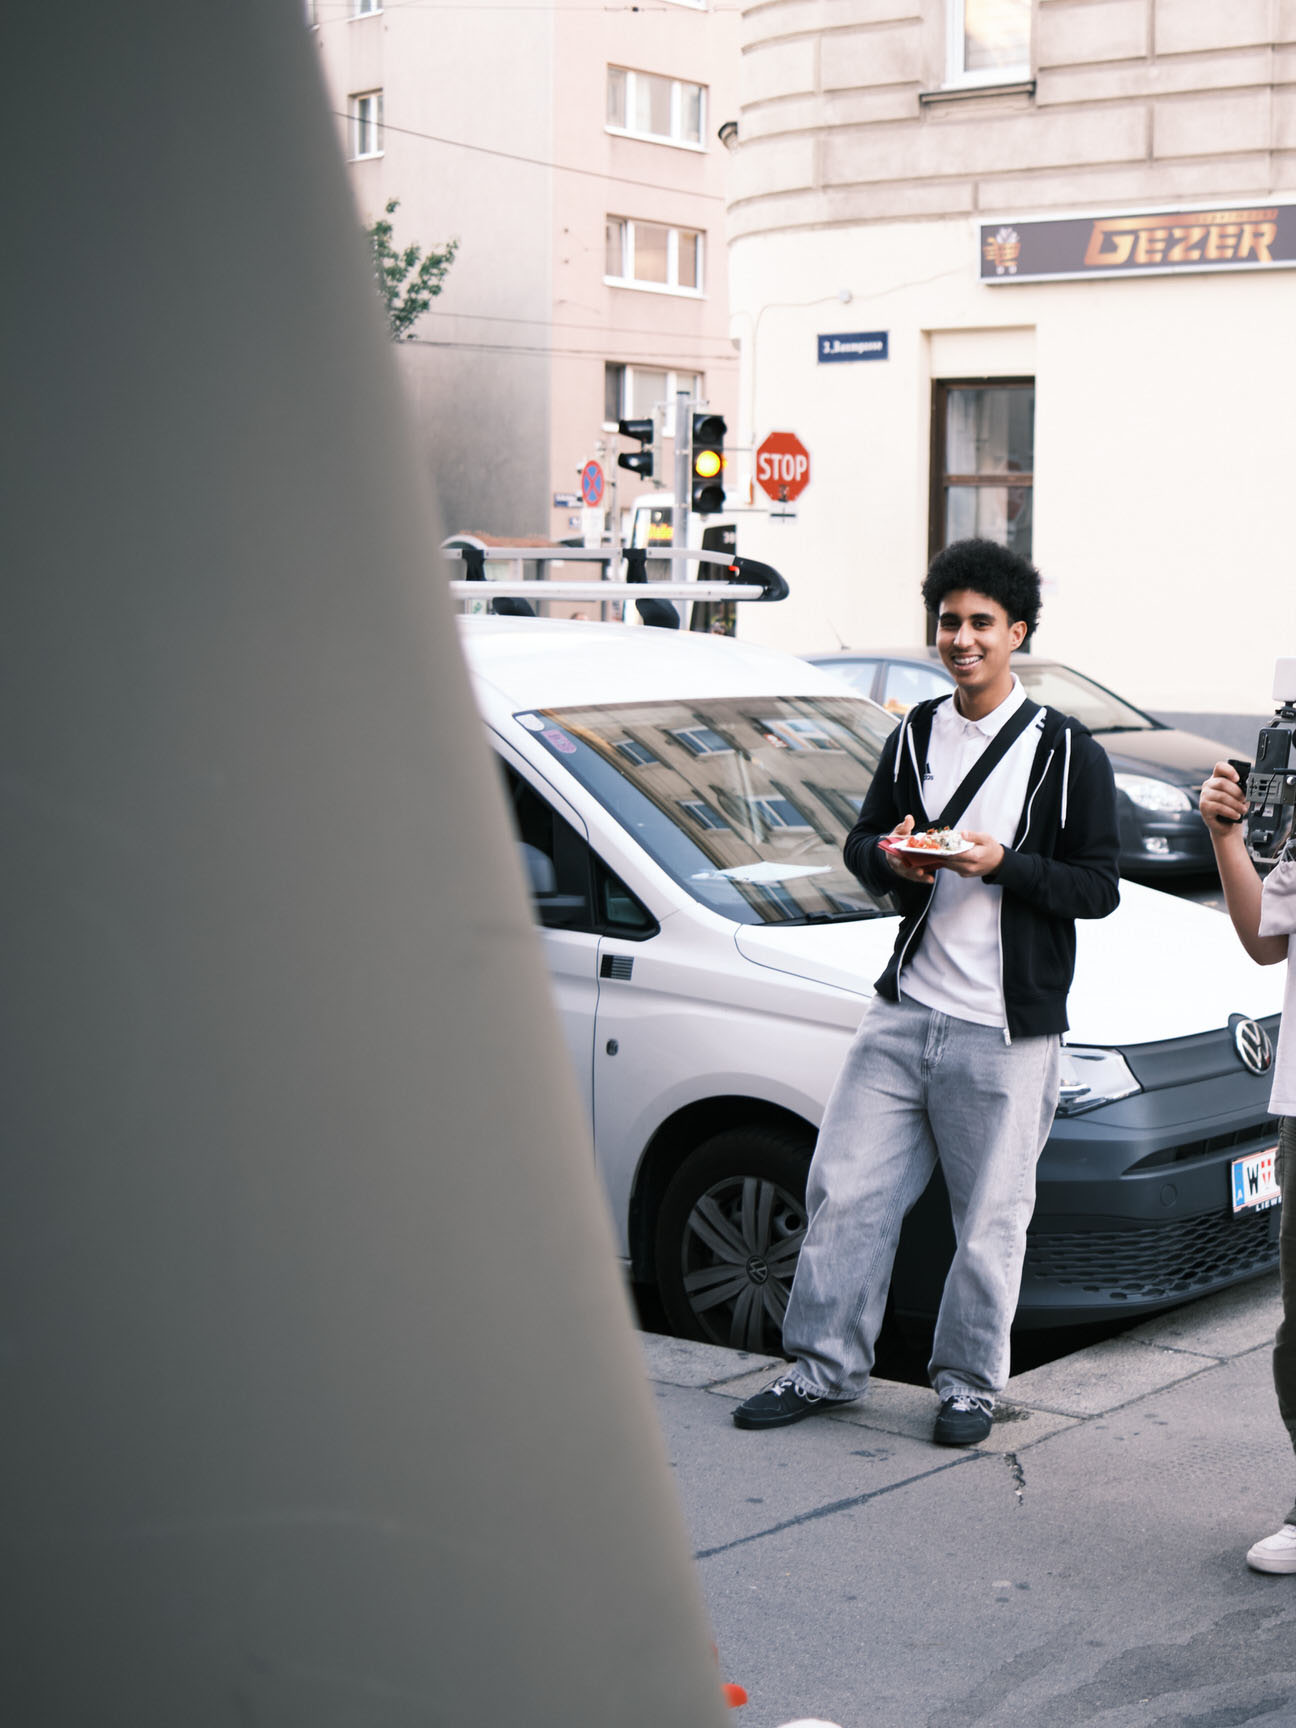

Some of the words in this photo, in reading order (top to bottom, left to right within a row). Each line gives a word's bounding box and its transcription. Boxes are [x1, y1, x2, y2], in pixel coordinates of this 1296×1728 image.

[1083, 209, 1278, 266] GEZER
[759, 453, 807, 481] STOP
[1247, 1163, 1259, 1196] W
